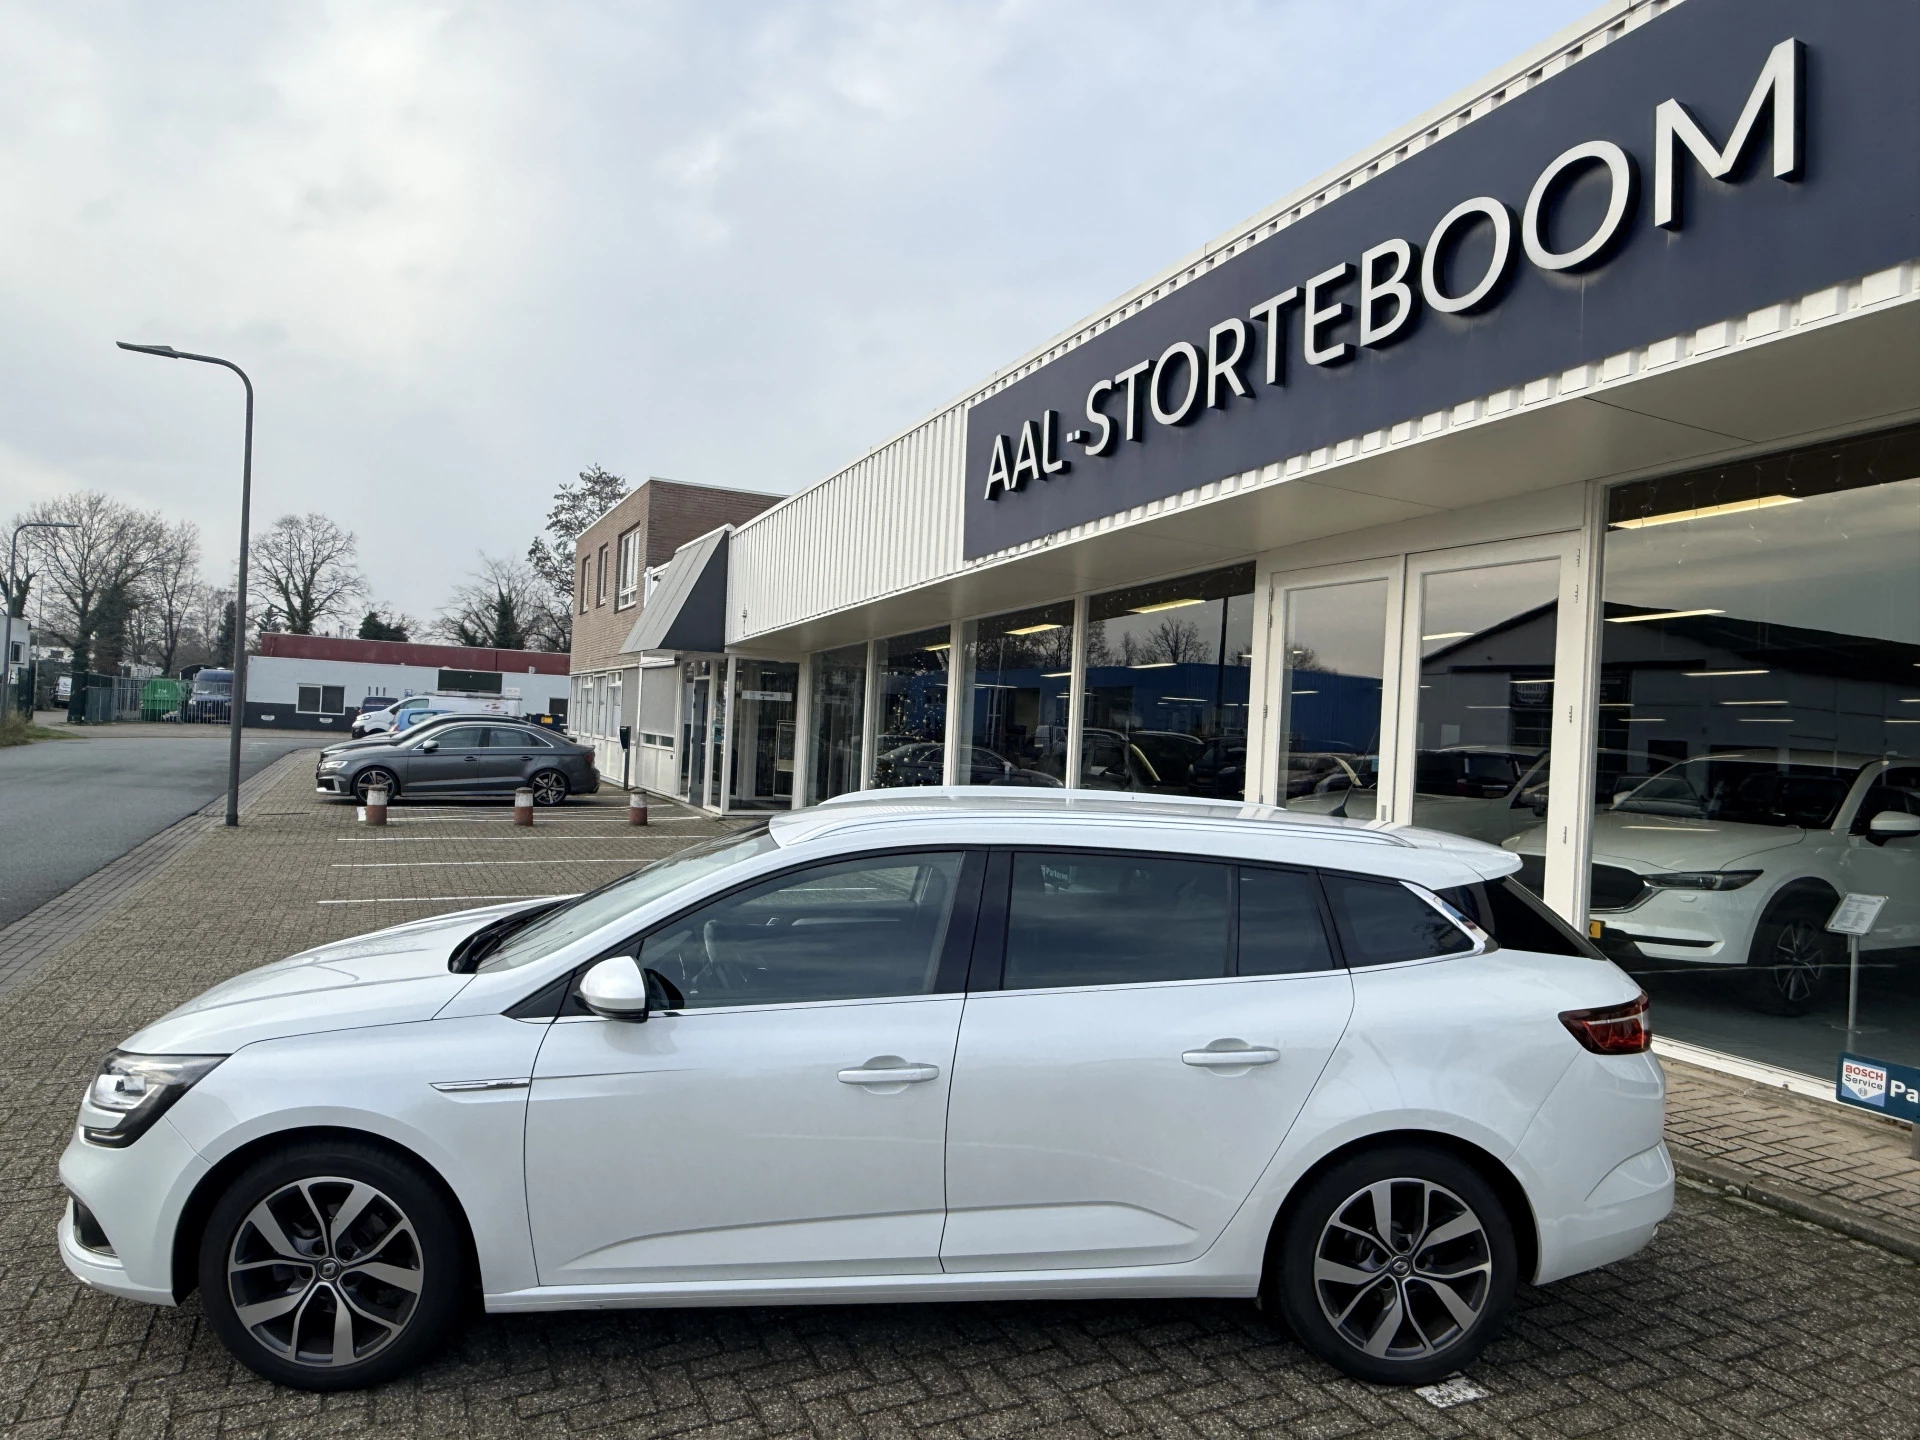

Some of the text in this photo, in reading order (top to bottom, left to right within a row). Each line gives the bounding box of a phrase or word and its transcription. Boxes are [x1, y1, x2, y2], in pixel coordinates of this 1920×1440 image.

[984, 37, 1798, 502] AAL-STORTEBOOM
[1844, 1073, 1883, 1091] Service
[1845, 1064, 1884, 1082] BOSCH
